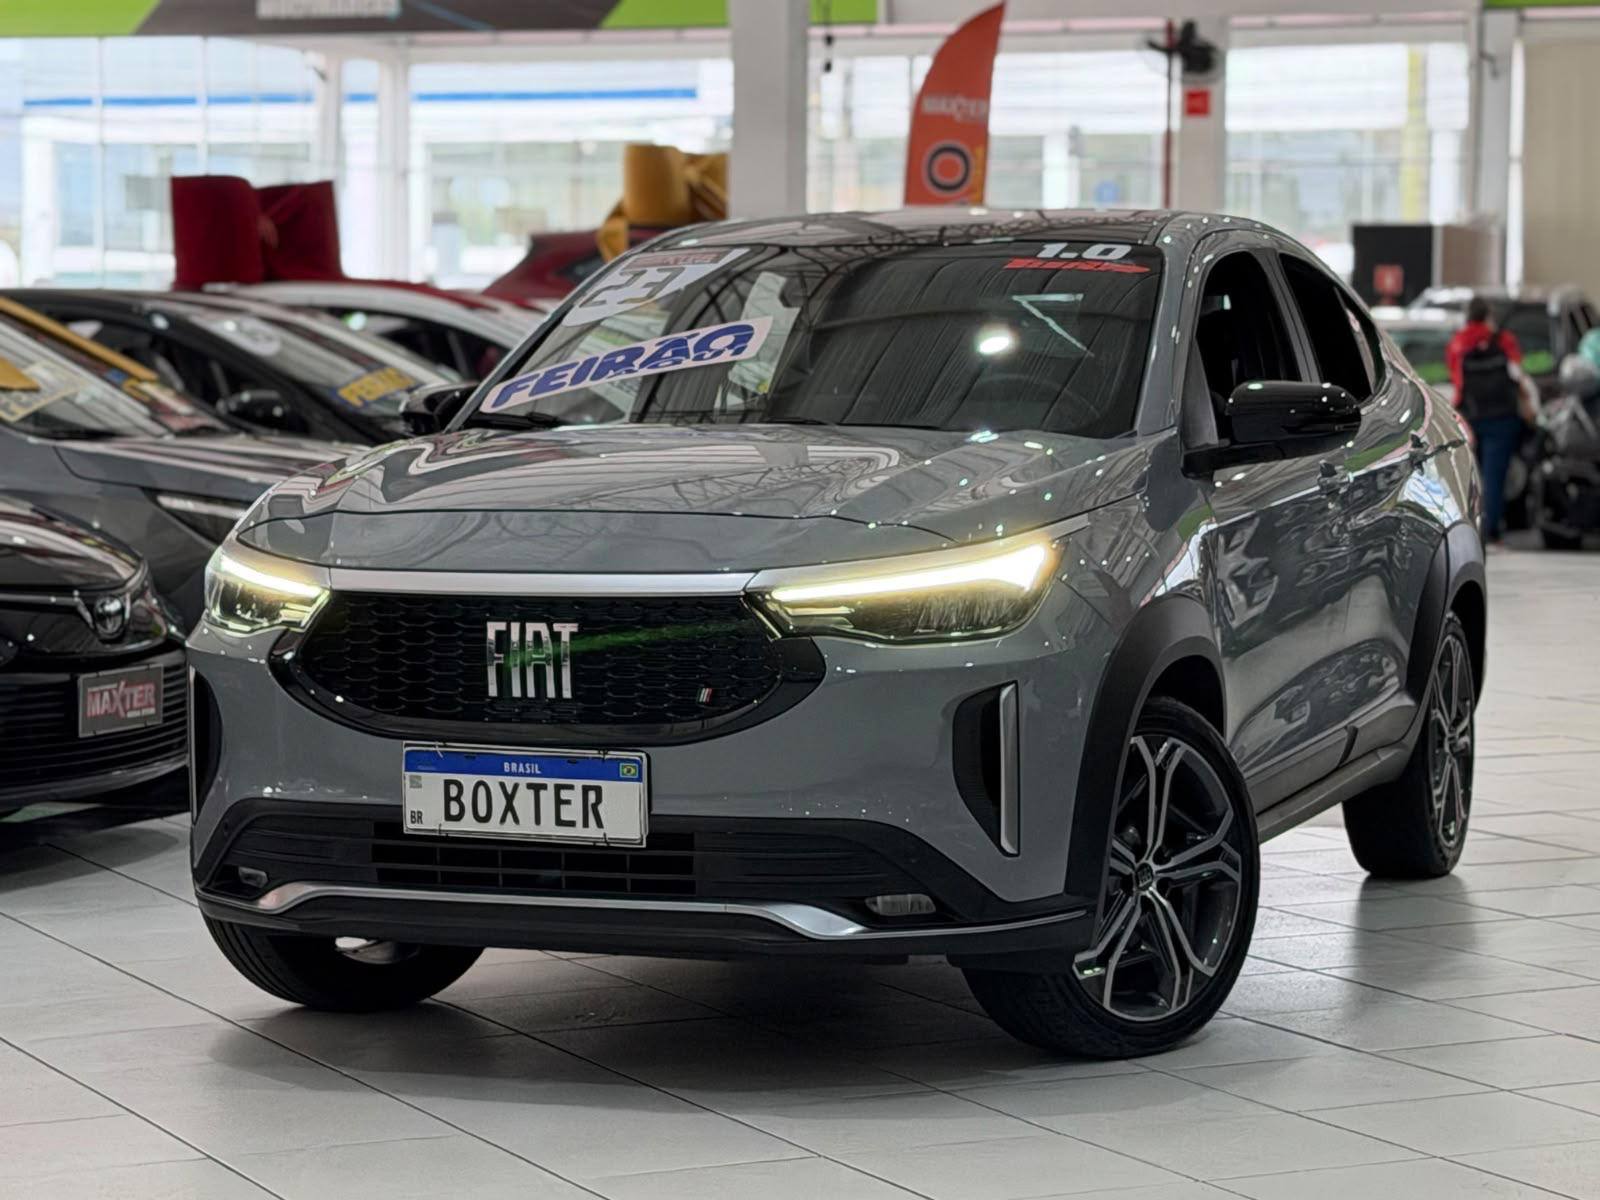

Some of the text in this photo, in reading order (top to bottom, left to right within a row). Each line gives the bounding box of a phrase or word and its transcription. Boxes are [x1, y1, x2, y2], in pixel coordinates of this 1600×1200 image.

[1036, 243, 1132, 260] 1.0
[487, 621, 579, 699] FIAT
[87, 680, 156, 718] MAXTER
[503, 761, 542, 775] BRASIL
[443, 778, 604, 829] BOXTER
[409, 810, 424, 825] BR
